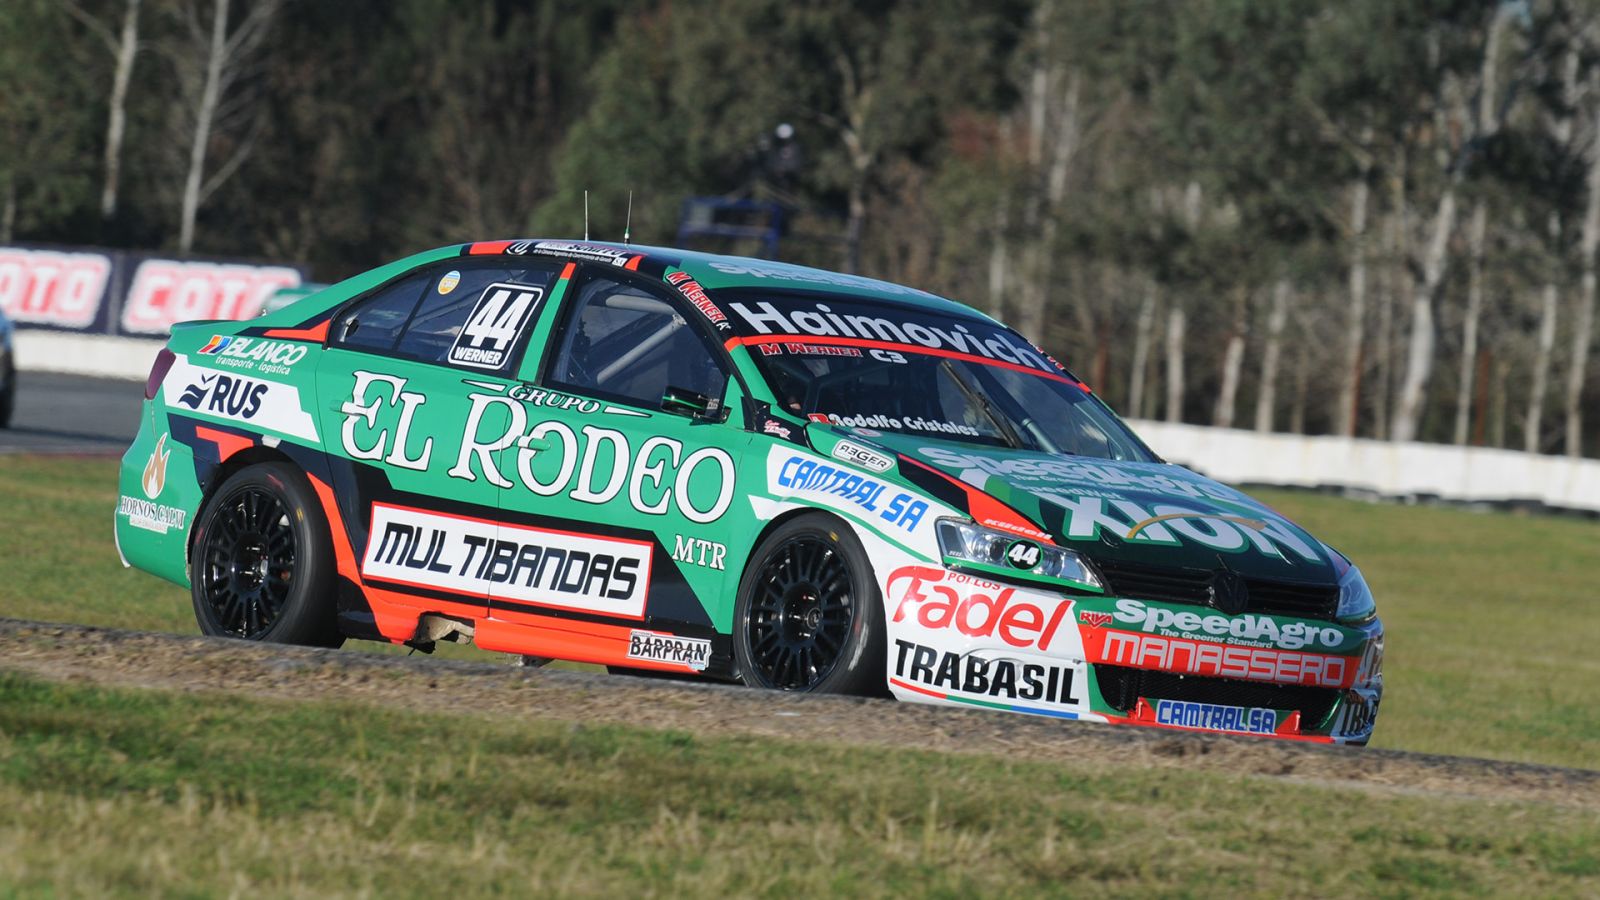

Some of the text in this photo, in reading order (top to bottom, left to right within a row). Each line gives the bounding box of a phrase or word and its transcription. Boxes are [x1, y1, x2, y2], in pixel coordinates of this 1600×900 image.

[0, 258, 98, 318] OTO
[666, 271, 692, 285] M
[464, 289, 535, 350] 44
[678, 281, 728, 324] WERNER
[222, 337, 308, 366] BLANCO
[728, 300, 1056, 373] Haimovich
[758, 342, 908, 364] M WERNER C3
[215, 355, 254, 369] transporte
[454, 346, 502, 365] WERNER
[208, 374, 268, 419] RUS
[508, 385, 600, 413] GRUPO
[828, 413, 902, 430] Rodolfo
[902, 416, 979, 437] Cristales
[340, 370, 736, 524] EL RODEO
[121, 495, 157, 521] HORNOS
[157, 505, 185, 529] CALVI
[778, 456, 929, 533] CAMTRAL SA
[1032, 491, 1321, 562] XION
[672, 534, 728, 571] MTR
[1008, 543, 1040, 566] 44
[886, 565, 1072, 651] Fadel
[1080, 610, 1113, 628] RIVA
[1112, 599, 1344, 649] SpeedAgro
[630, 634, 707, 662] BARPRAN
[1160, 628, 1273, 649] The Greener Standard
[895, 639, 1080, 705] TRABASIL
[1101, 631, 1346, 686] MANASSERO
[1157, 700, 1276, 734] CAMTRAL SA
